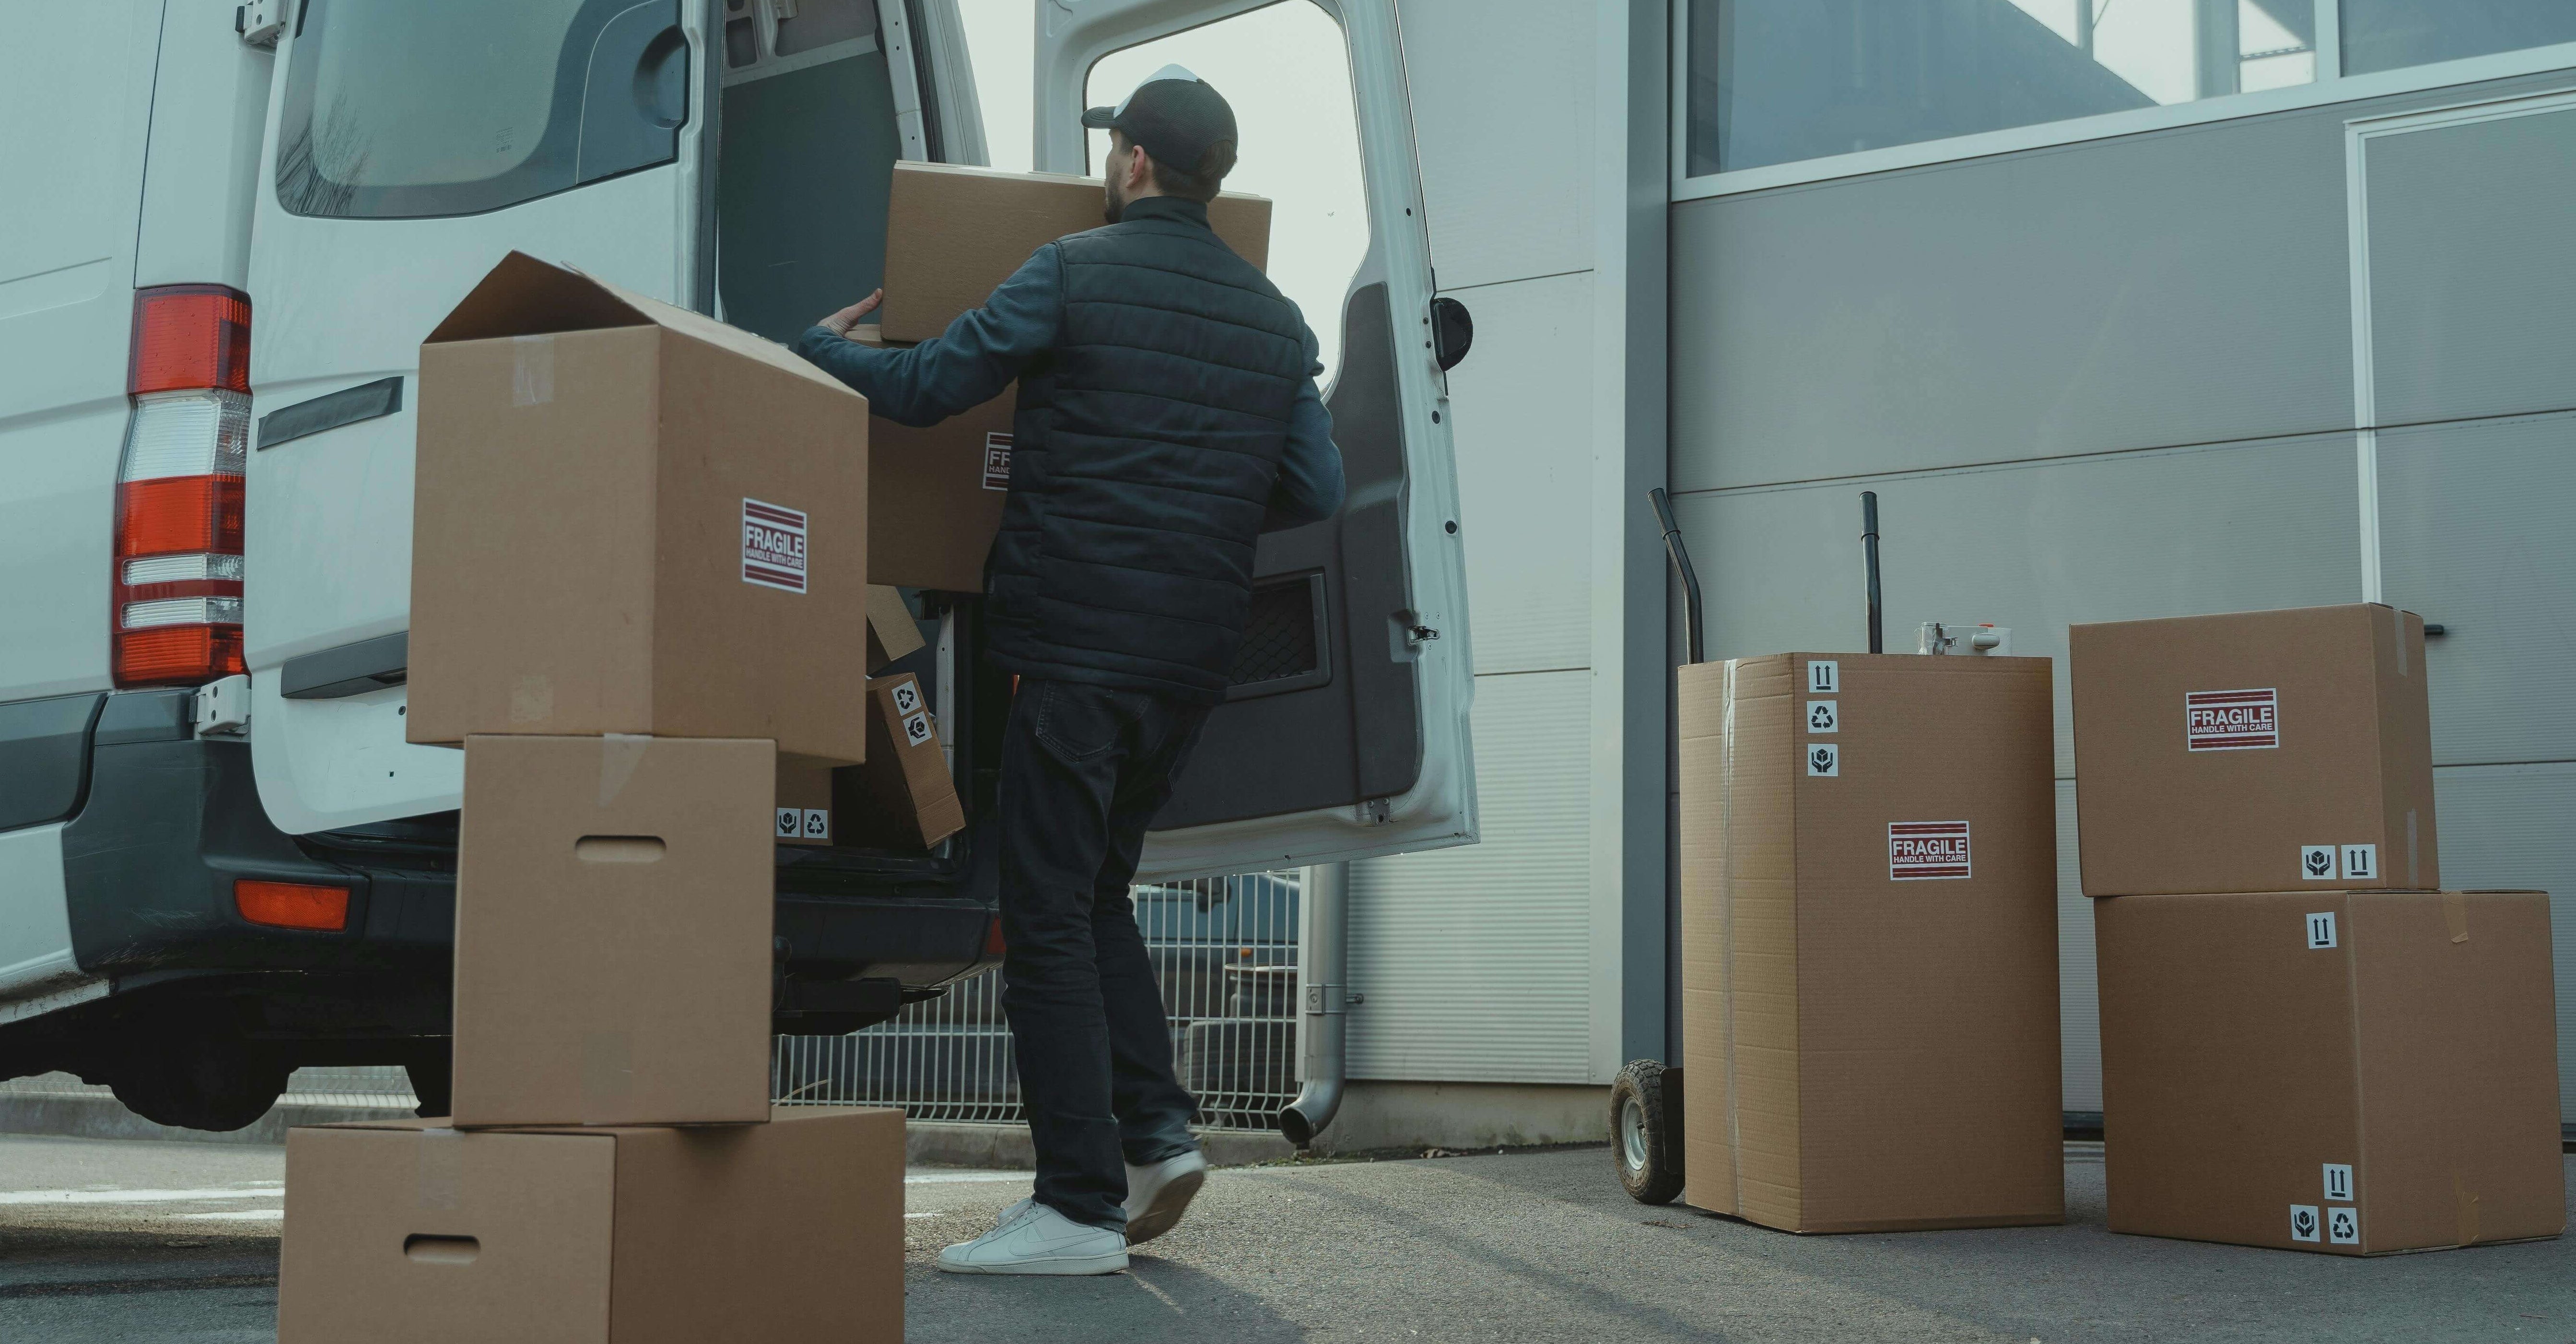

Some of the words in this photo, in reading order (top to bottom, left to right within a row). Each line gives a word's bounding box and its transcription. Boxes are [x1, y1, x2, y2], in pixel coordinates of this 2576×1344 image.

[746, 525, 803, 558] FRAGILE
[746, 547, 771, 562] HANDLE
[771, 553, 786, 566] WITH
[786, 556, 803, 568] CARE
[2190, 707, 2272, 726] FRAGILE
[2192, 725, 2225, 733] HANDLE
[2249, 723, 2272, 731] CARE
[1893, 839, 1966, 856] FRAGILE
[1894, 855, 1924, 863] HANDLE
